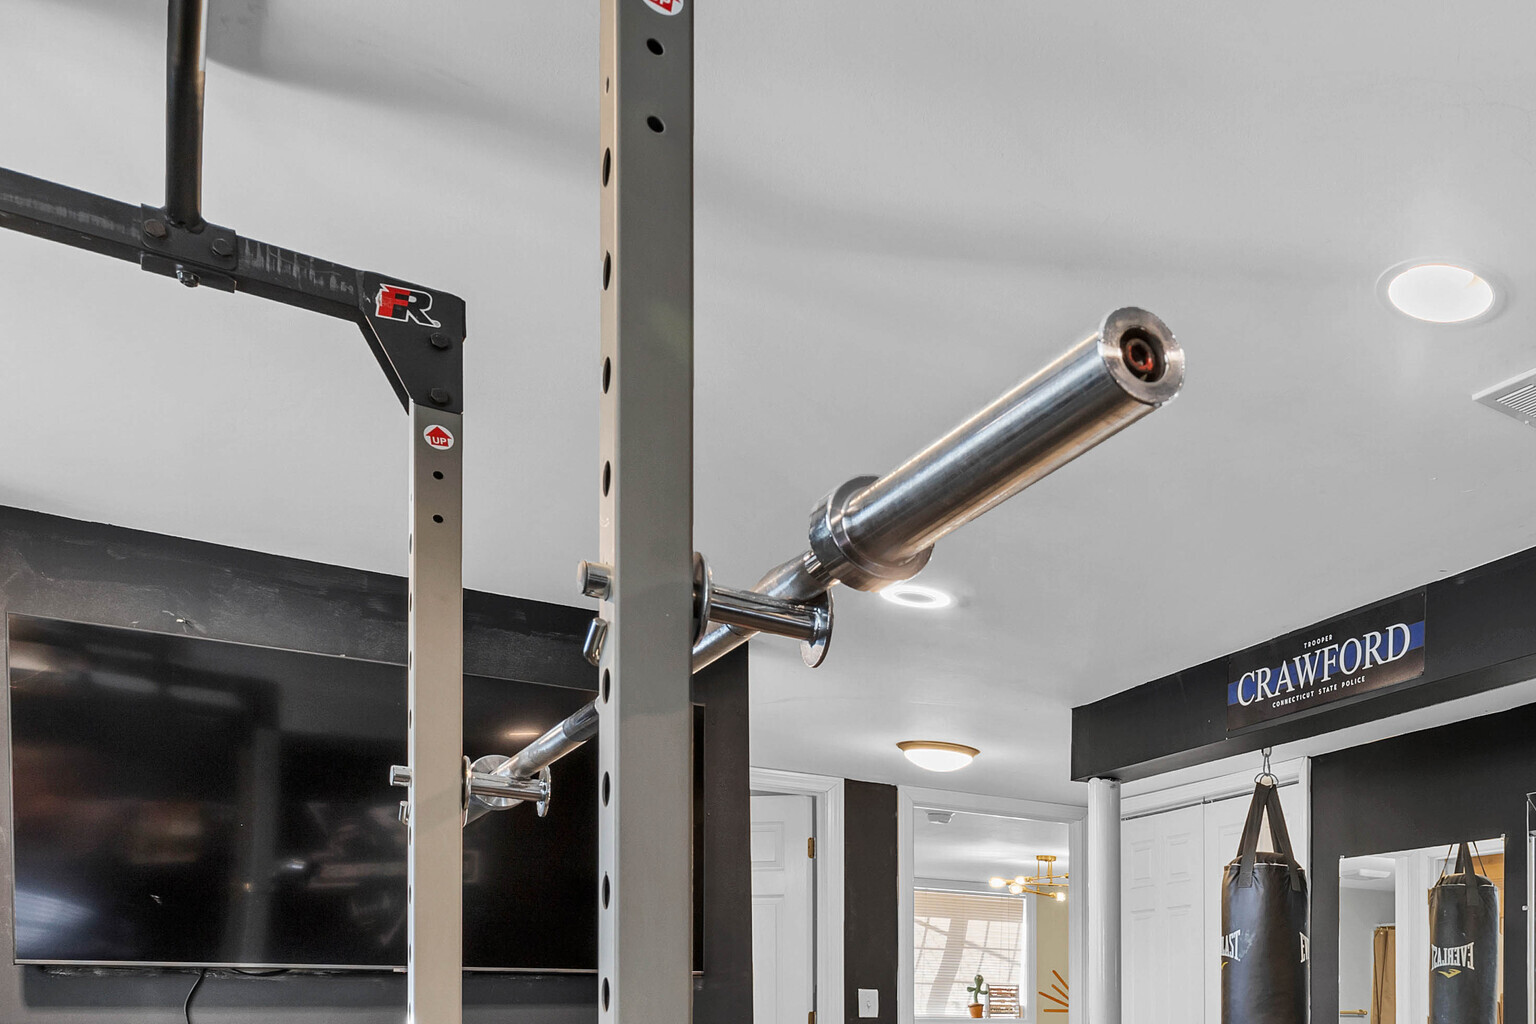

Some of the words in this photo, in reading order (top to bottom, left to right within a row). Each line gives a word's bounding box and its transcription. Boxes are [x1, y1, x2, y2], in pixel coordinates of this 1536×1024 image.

[431, 435, 448, 446] UP
[1303, 634, 1333, 650] TROOPER
[1237, 622, 1411, 706] CRAWFORD
[1271, 690, 1315, 709] CONNECTICUT
[1318, 683, 1338, 696] STATE
[1341, 675, 1366, 689] POLICE
